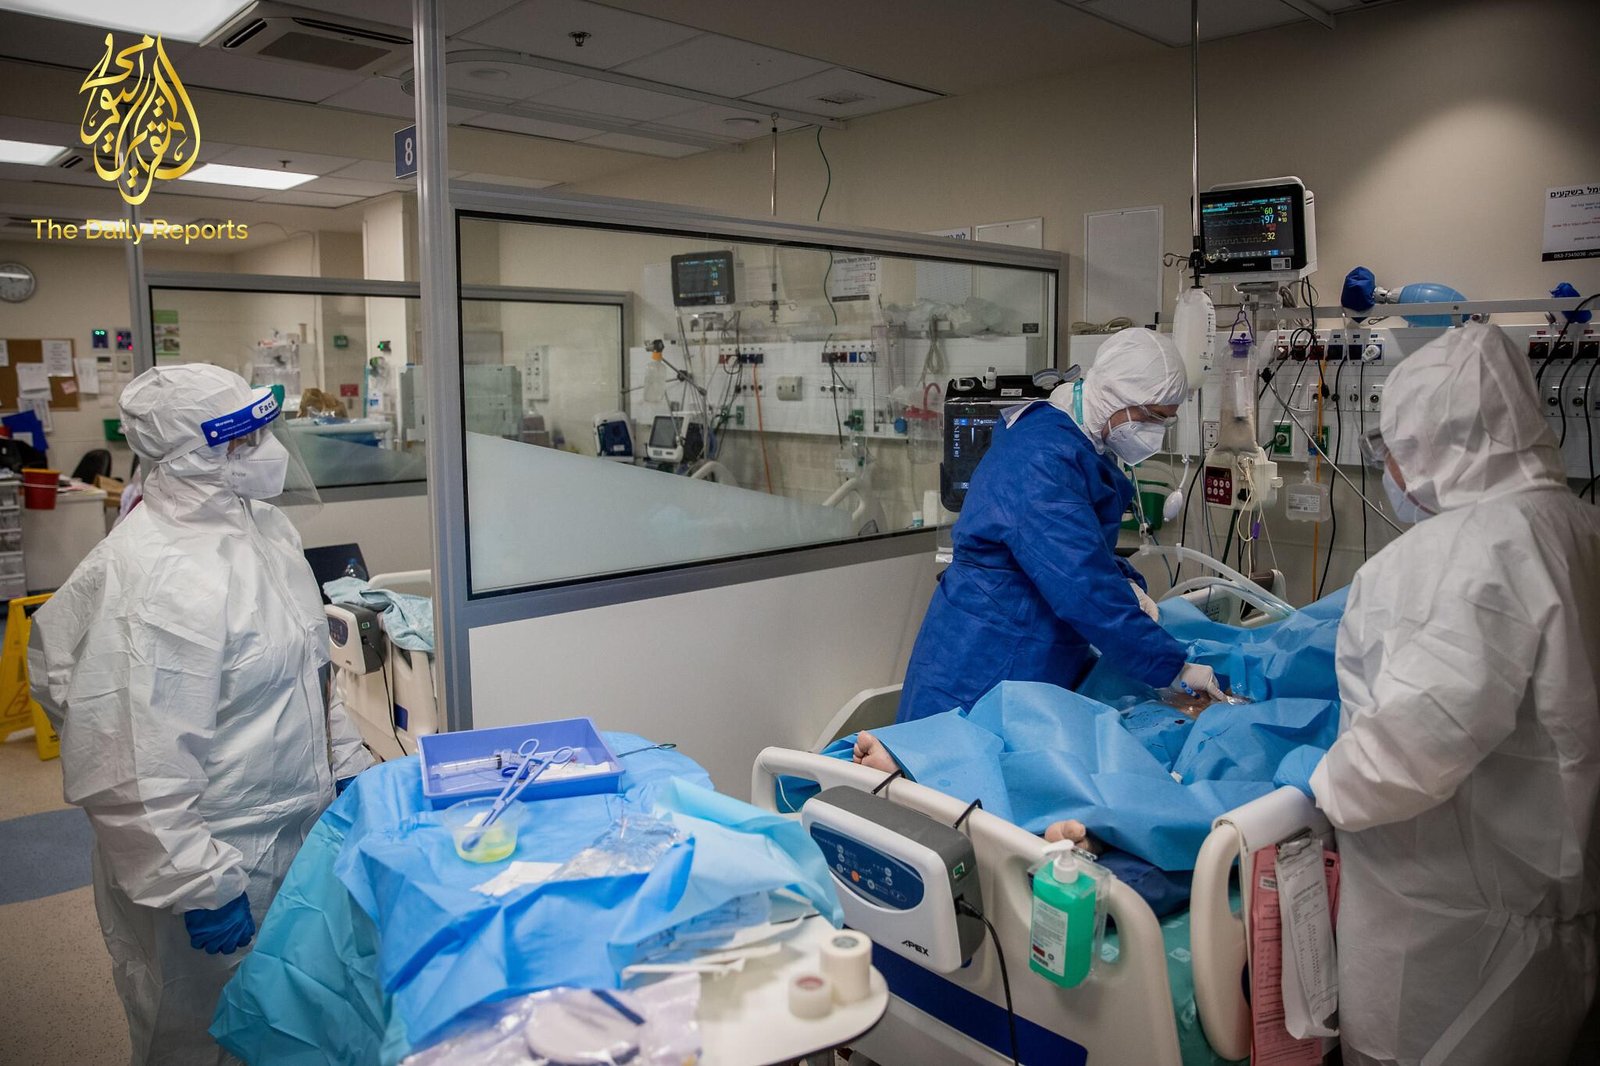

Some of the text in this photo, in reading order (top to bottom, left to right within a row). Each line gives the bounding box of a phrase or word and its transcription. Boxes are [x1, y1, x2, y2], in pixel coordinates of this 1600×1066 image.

[404, 137, 413, 166] 8
[1550, 186, 1600, 198] מל בשקעים
[1264, 215, 1274, 223] 97
[1266, 232, 1275, 240] 32
[901, 940, 929, 956] APEX
